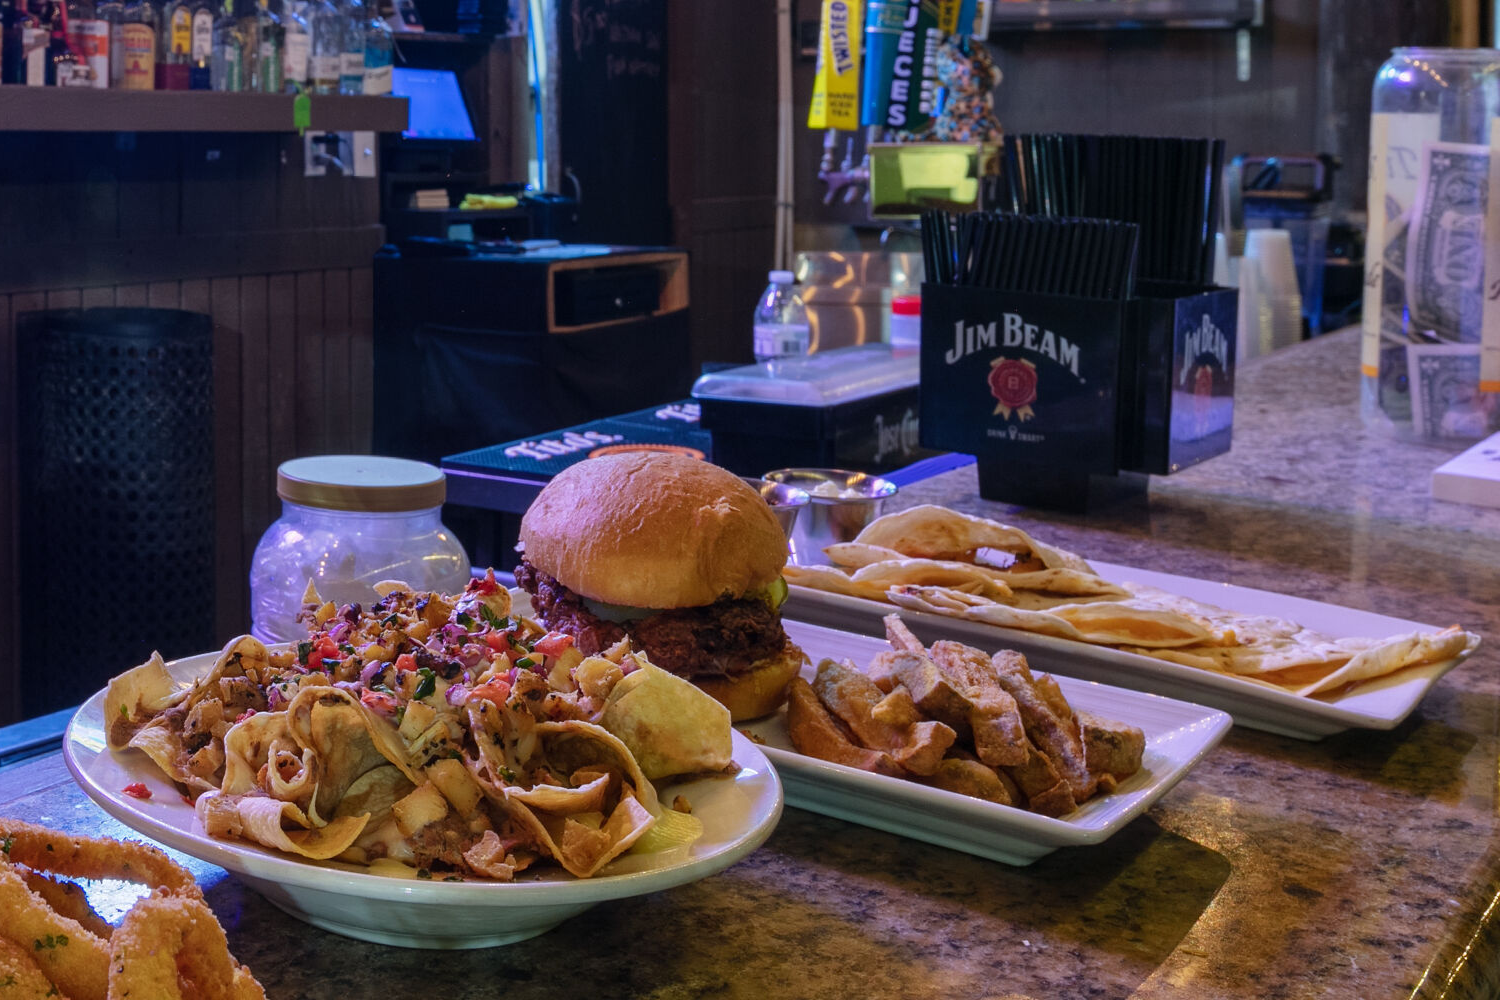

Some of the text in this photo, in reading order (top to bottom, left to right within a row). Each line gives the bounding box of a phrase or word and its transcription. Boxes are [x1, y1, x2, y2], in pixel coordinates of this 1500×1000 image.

[830, 1, 854, 76] TWISTED
[945, 312, 1081, 378] JIM BEAM
